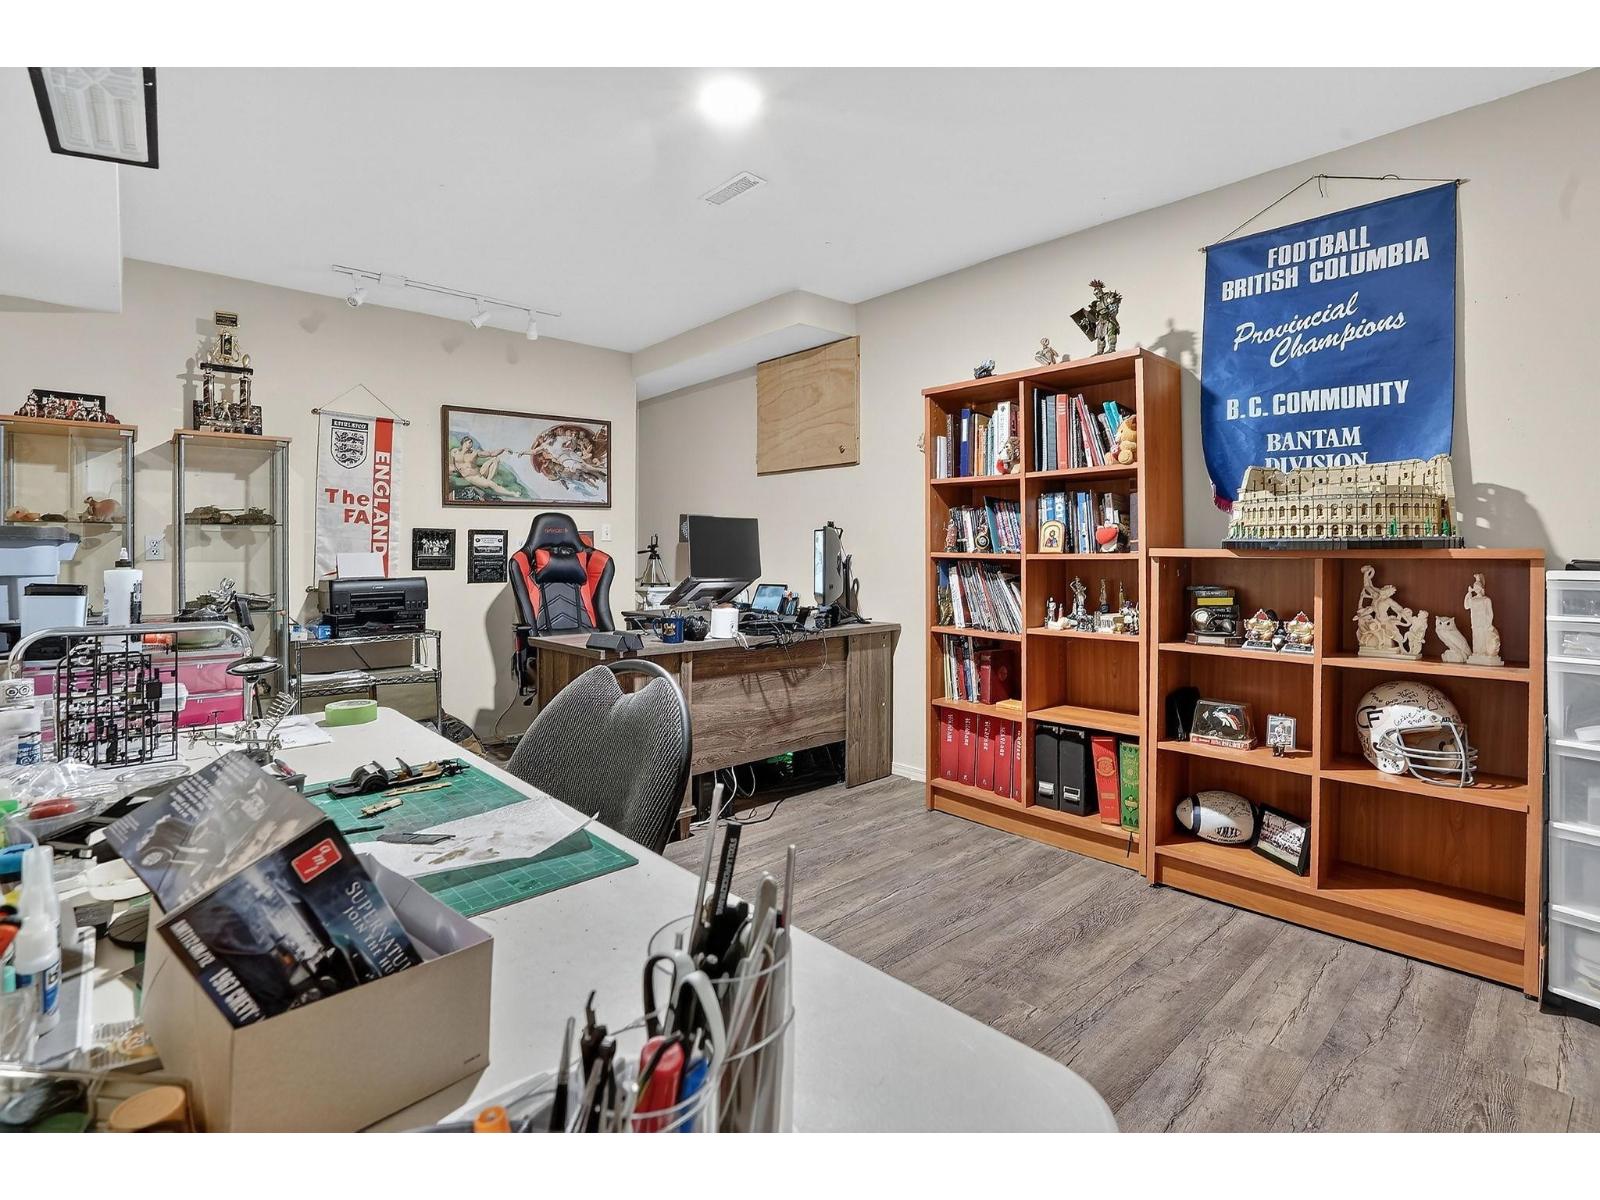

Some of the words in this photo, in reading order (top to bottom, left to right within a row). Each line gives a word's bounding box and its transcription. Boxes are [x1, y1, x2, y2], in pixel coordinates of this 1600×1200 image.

[1267, 225, 1370, 269] FOOTBALL
[1221, 267, 1299, 302] BRITISH
[1309, 236, 1430, 284] COLUMBIA
[1233, 291, 1359, 351] Provincial
[1269, 311, 1407, 368] Champions
[1272, 380, 1409, 414] COMMUNITY
[1266, 426, 1361, 452] BANTAM
[325, 488, 370, 507] The
[372, 451, 391, 557] ENGLAND
[343, 508, 371, 524] FA
[342, 905, 368, 934] JOIN
[208, 966, 241, 996] 1967
